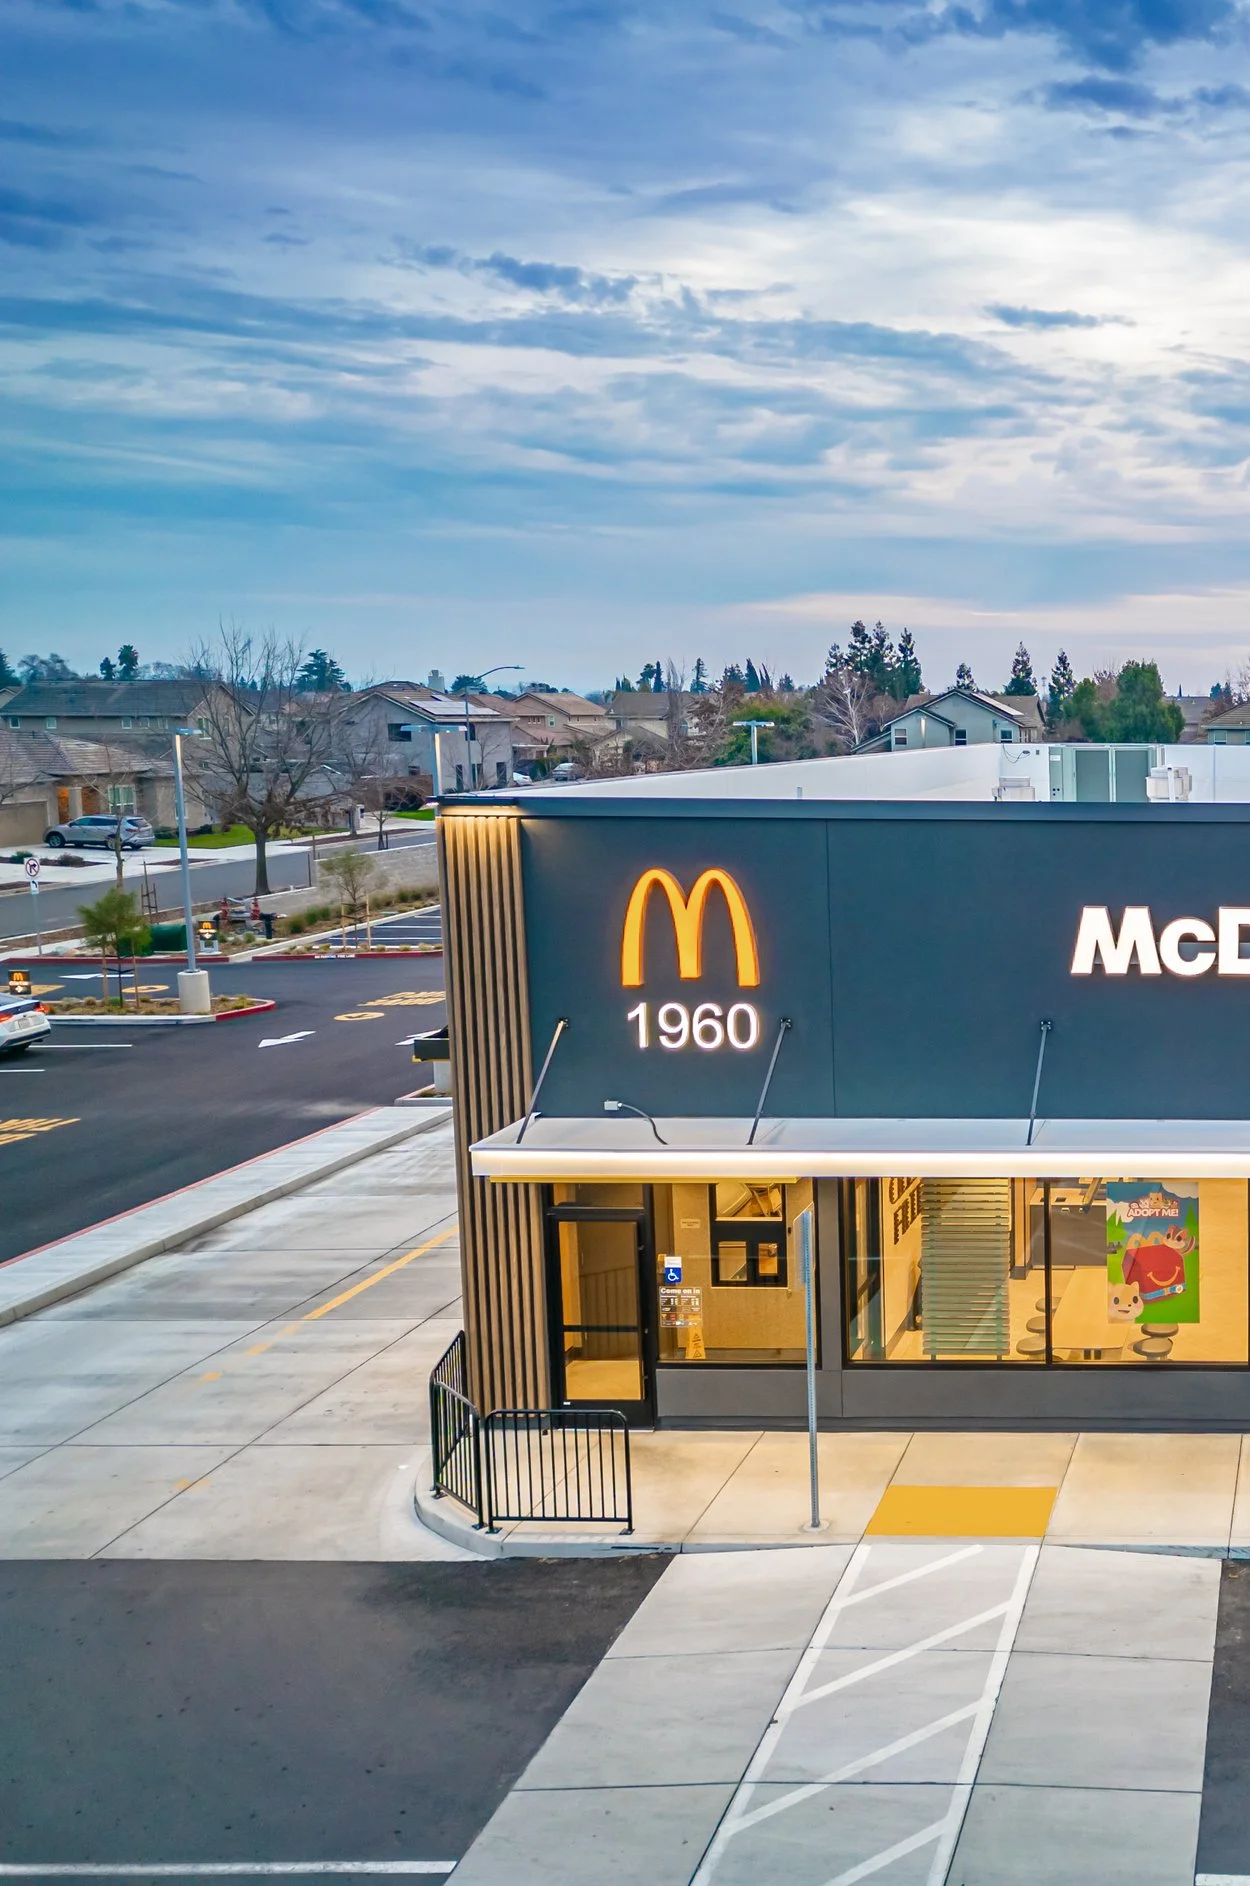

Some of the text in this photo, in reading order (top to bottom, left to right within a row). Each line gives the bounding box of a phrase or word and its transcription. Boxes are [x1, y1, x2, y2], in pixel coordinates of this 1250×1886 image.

[627, 1002, 759, 1049] 1960
[1127, 1208, 1179, 1217] ADOPT ME!
